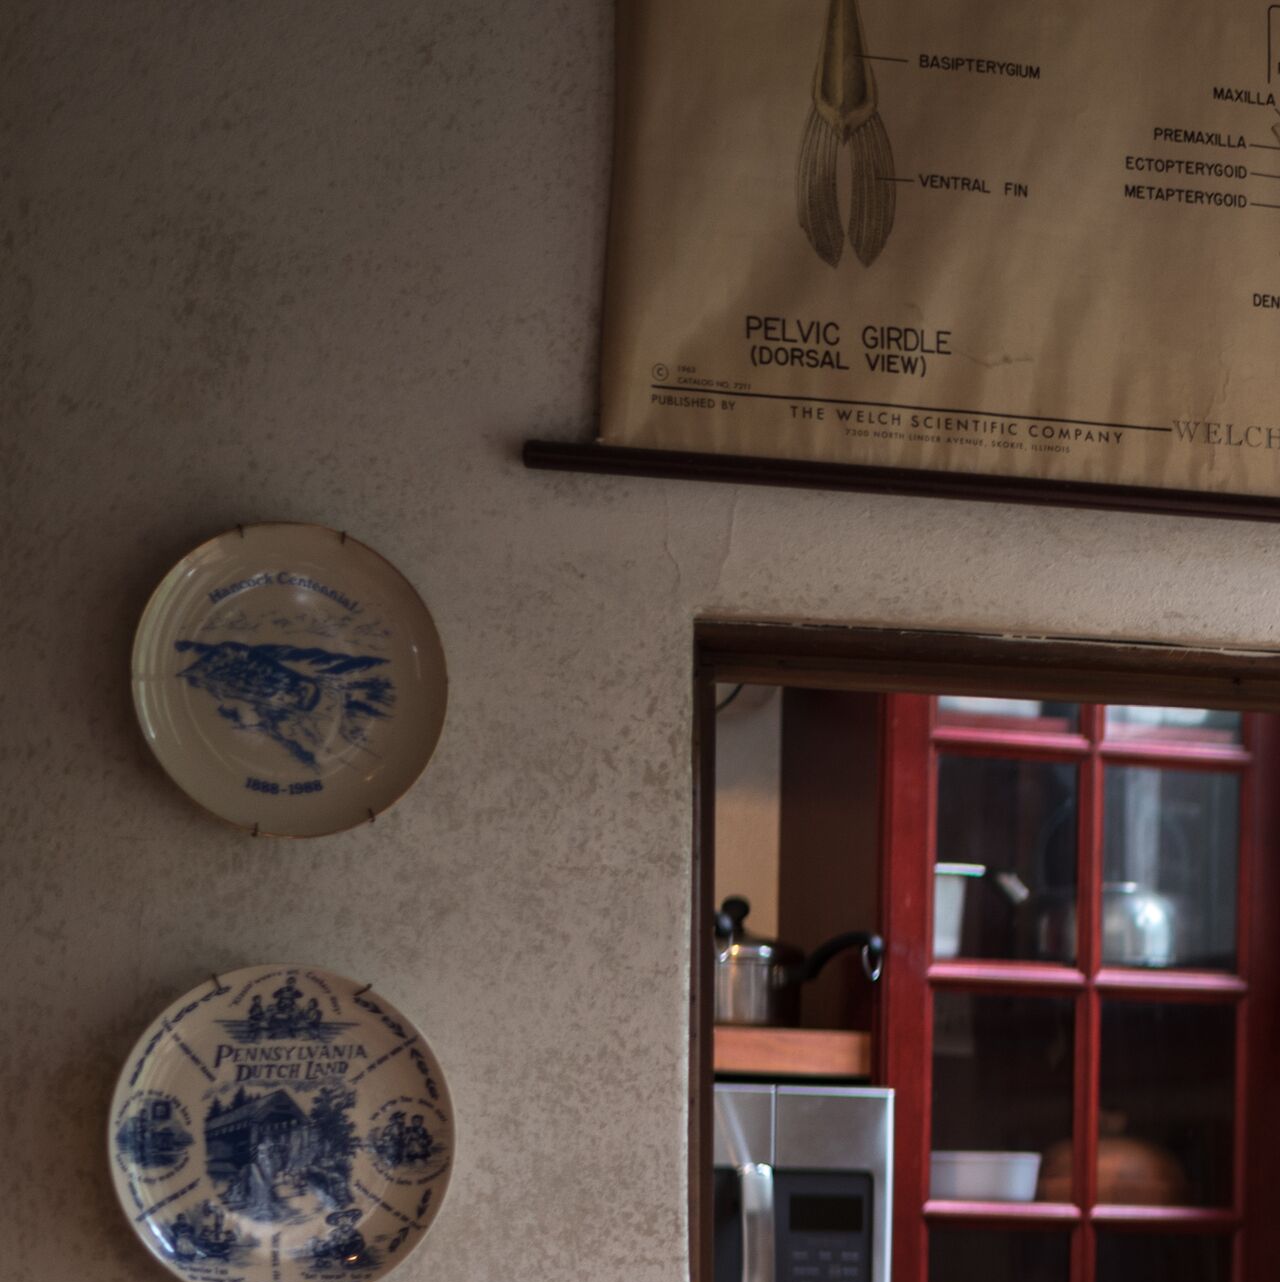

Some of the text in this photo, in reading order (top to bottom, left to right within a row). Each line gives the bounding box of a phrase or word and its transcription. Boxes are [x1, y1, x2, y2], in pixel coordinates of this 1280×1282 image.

[918, 54, 1041, 80] BASIPTERYGIUM
[1212, 87, 1276, 107] MAXILLA
[1153, 128, 1247, 149] PREMAXILLA
[1125, 156, 1248, 180] ECTOPTERYGOID
[918, 174, 1029, 198] VENTRAL FIN
[1124, 185, 1248, 208] METAPTERYGOID
[745, 315, 952, 356] PELVIC GIRDLE
[750, 345, 928, 378] (DORSAL VIEW)
[677, 377, 714, 387] CATALOG
[650, 394, 736, 411] PUBLISHED BY
[790, 405, 1123, 444] THE WELCH SCIENTIFIC COMPANY
[873, 430, 905, 440] NORTH
[1031, 444, 1071, 454] ILLINOIS
[208, 571, 361, 612] Hancock Centennial
[245, 777, 323, 795] 1888-1988
[214, 1044, 368, 1069] PENNSYLVANIA
[236, 1063, 301, 1083] DUTCH
[305, 1060, 349, 1080] LAND
